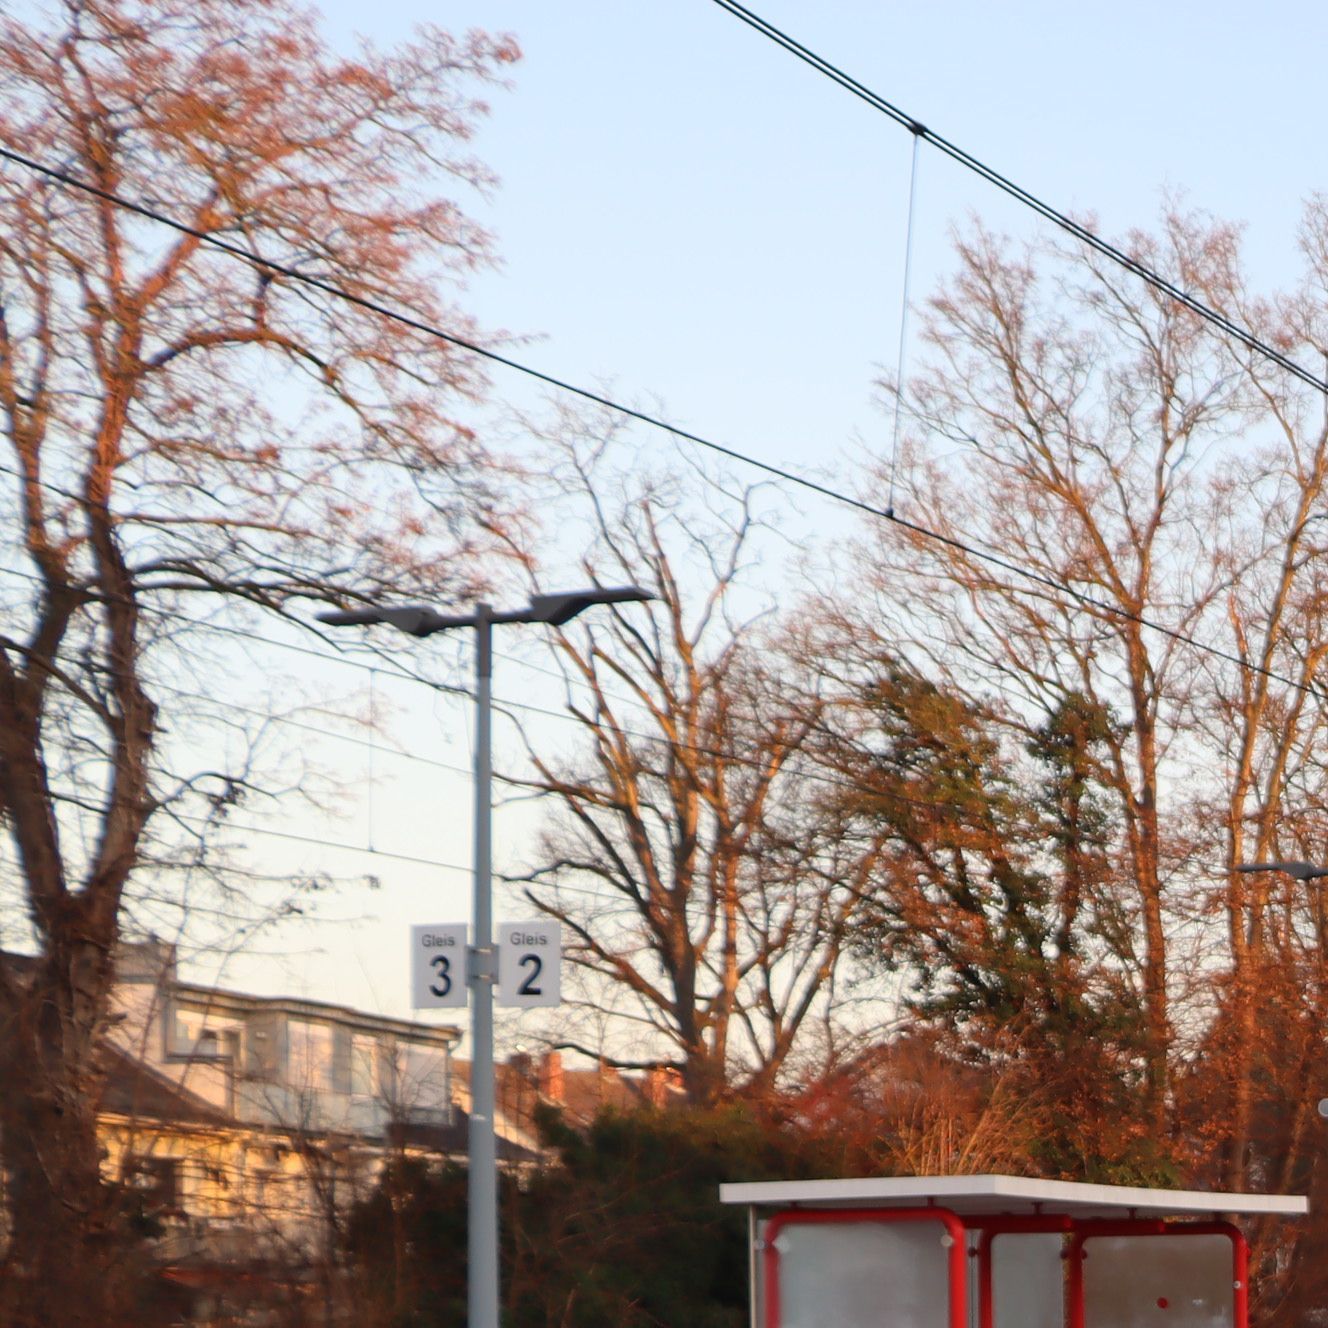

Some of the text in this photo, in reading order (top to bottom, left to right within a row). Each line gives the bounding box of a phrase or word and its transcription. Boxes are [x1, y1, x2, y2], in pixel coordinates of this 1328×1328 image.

[421, 934, 456, 948] Gleis
[510, 931, 548, 946] Gleis
[428, 954, 452, 998] 3
[516, 952, 543, 996] 2
